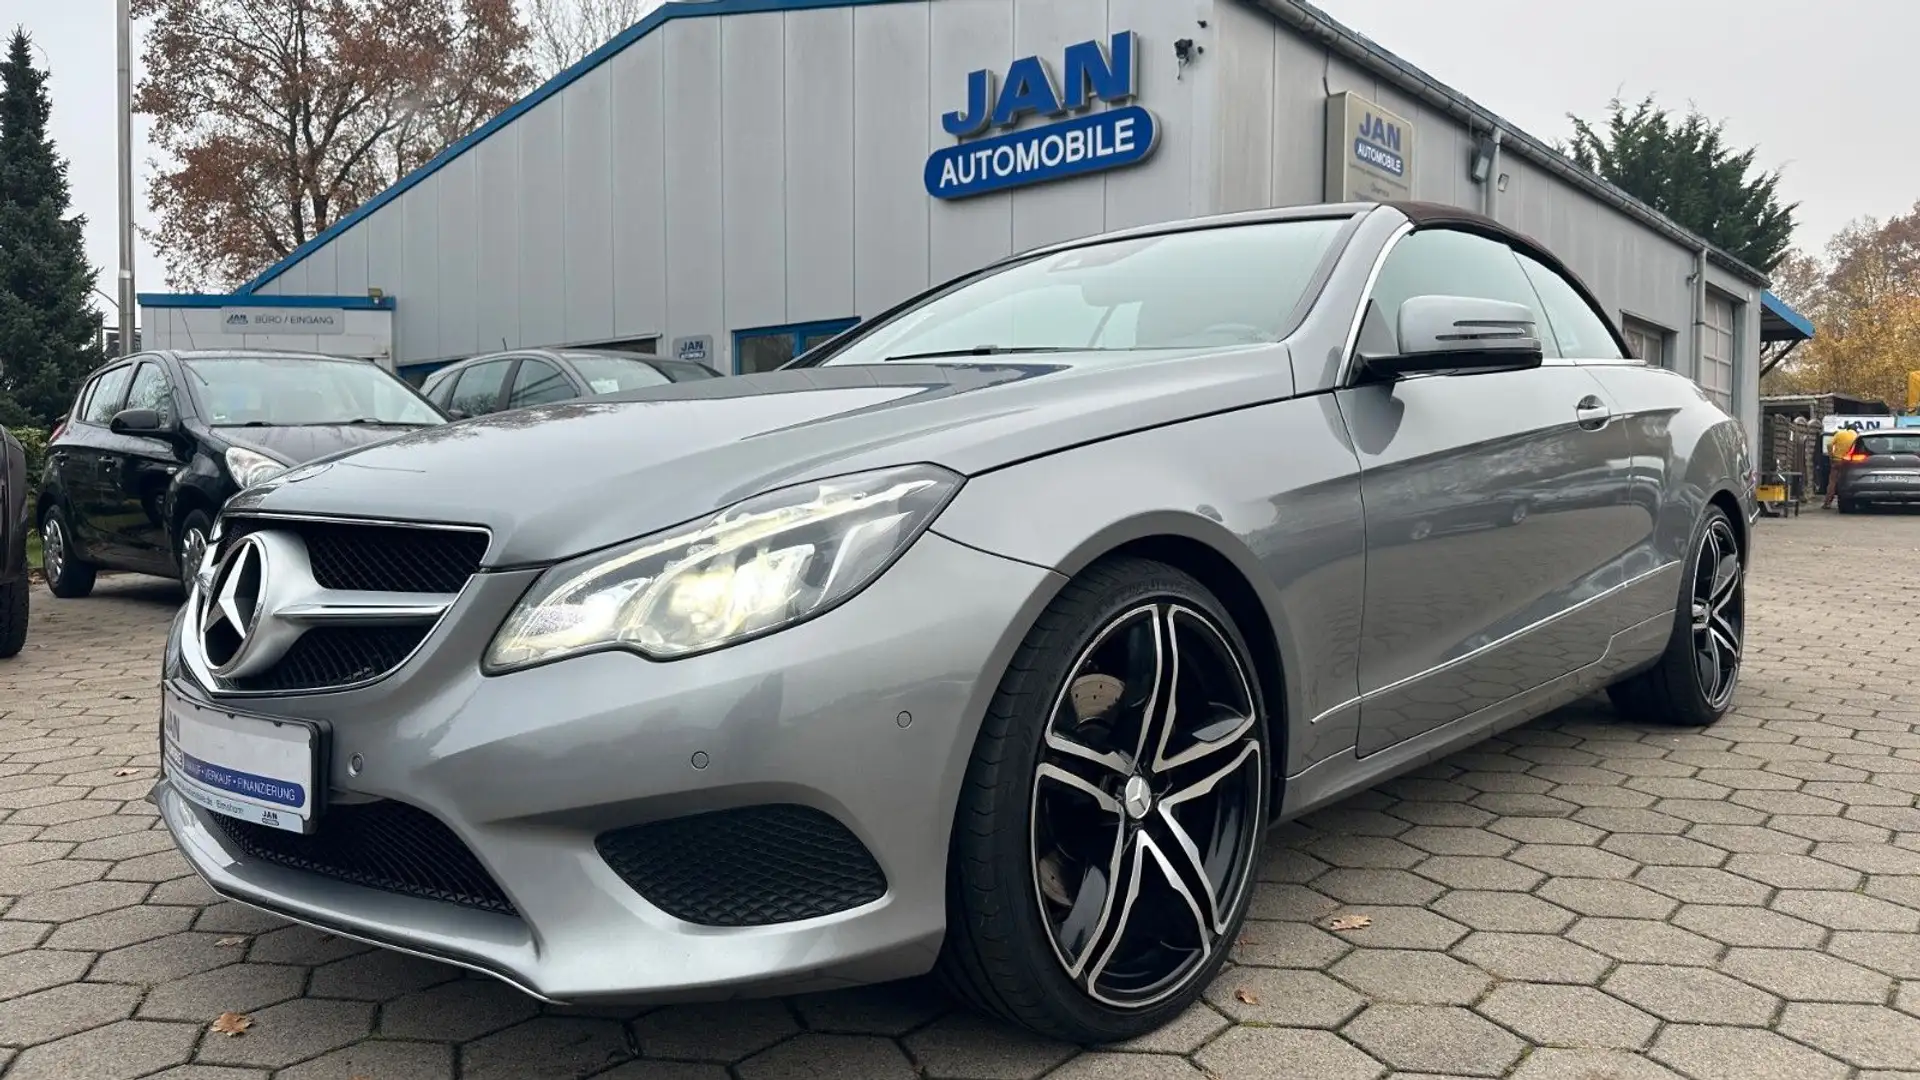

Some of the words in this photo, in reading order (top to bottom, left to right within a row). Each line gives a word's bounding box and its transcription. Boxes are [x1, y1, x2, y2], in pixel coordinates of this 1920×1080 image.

[942, 30, 1135, 136] JAN
[1359, 111, 1401, 152] JAN
[939, 117, 1135, 188] AUTOMOBILE
[1357, 142, 1401, 173] AUTOMOBILE
[255, 314, 282, 324] BÜRO
[290, 315, 334, 325] EINGANG
[681, 340, 703, 351] JAN
[1837, 420, 1881, 431] JAN
[237, 777, 296, 801] FINANZIERUNG
[262, 810, 278, 820] JAN
